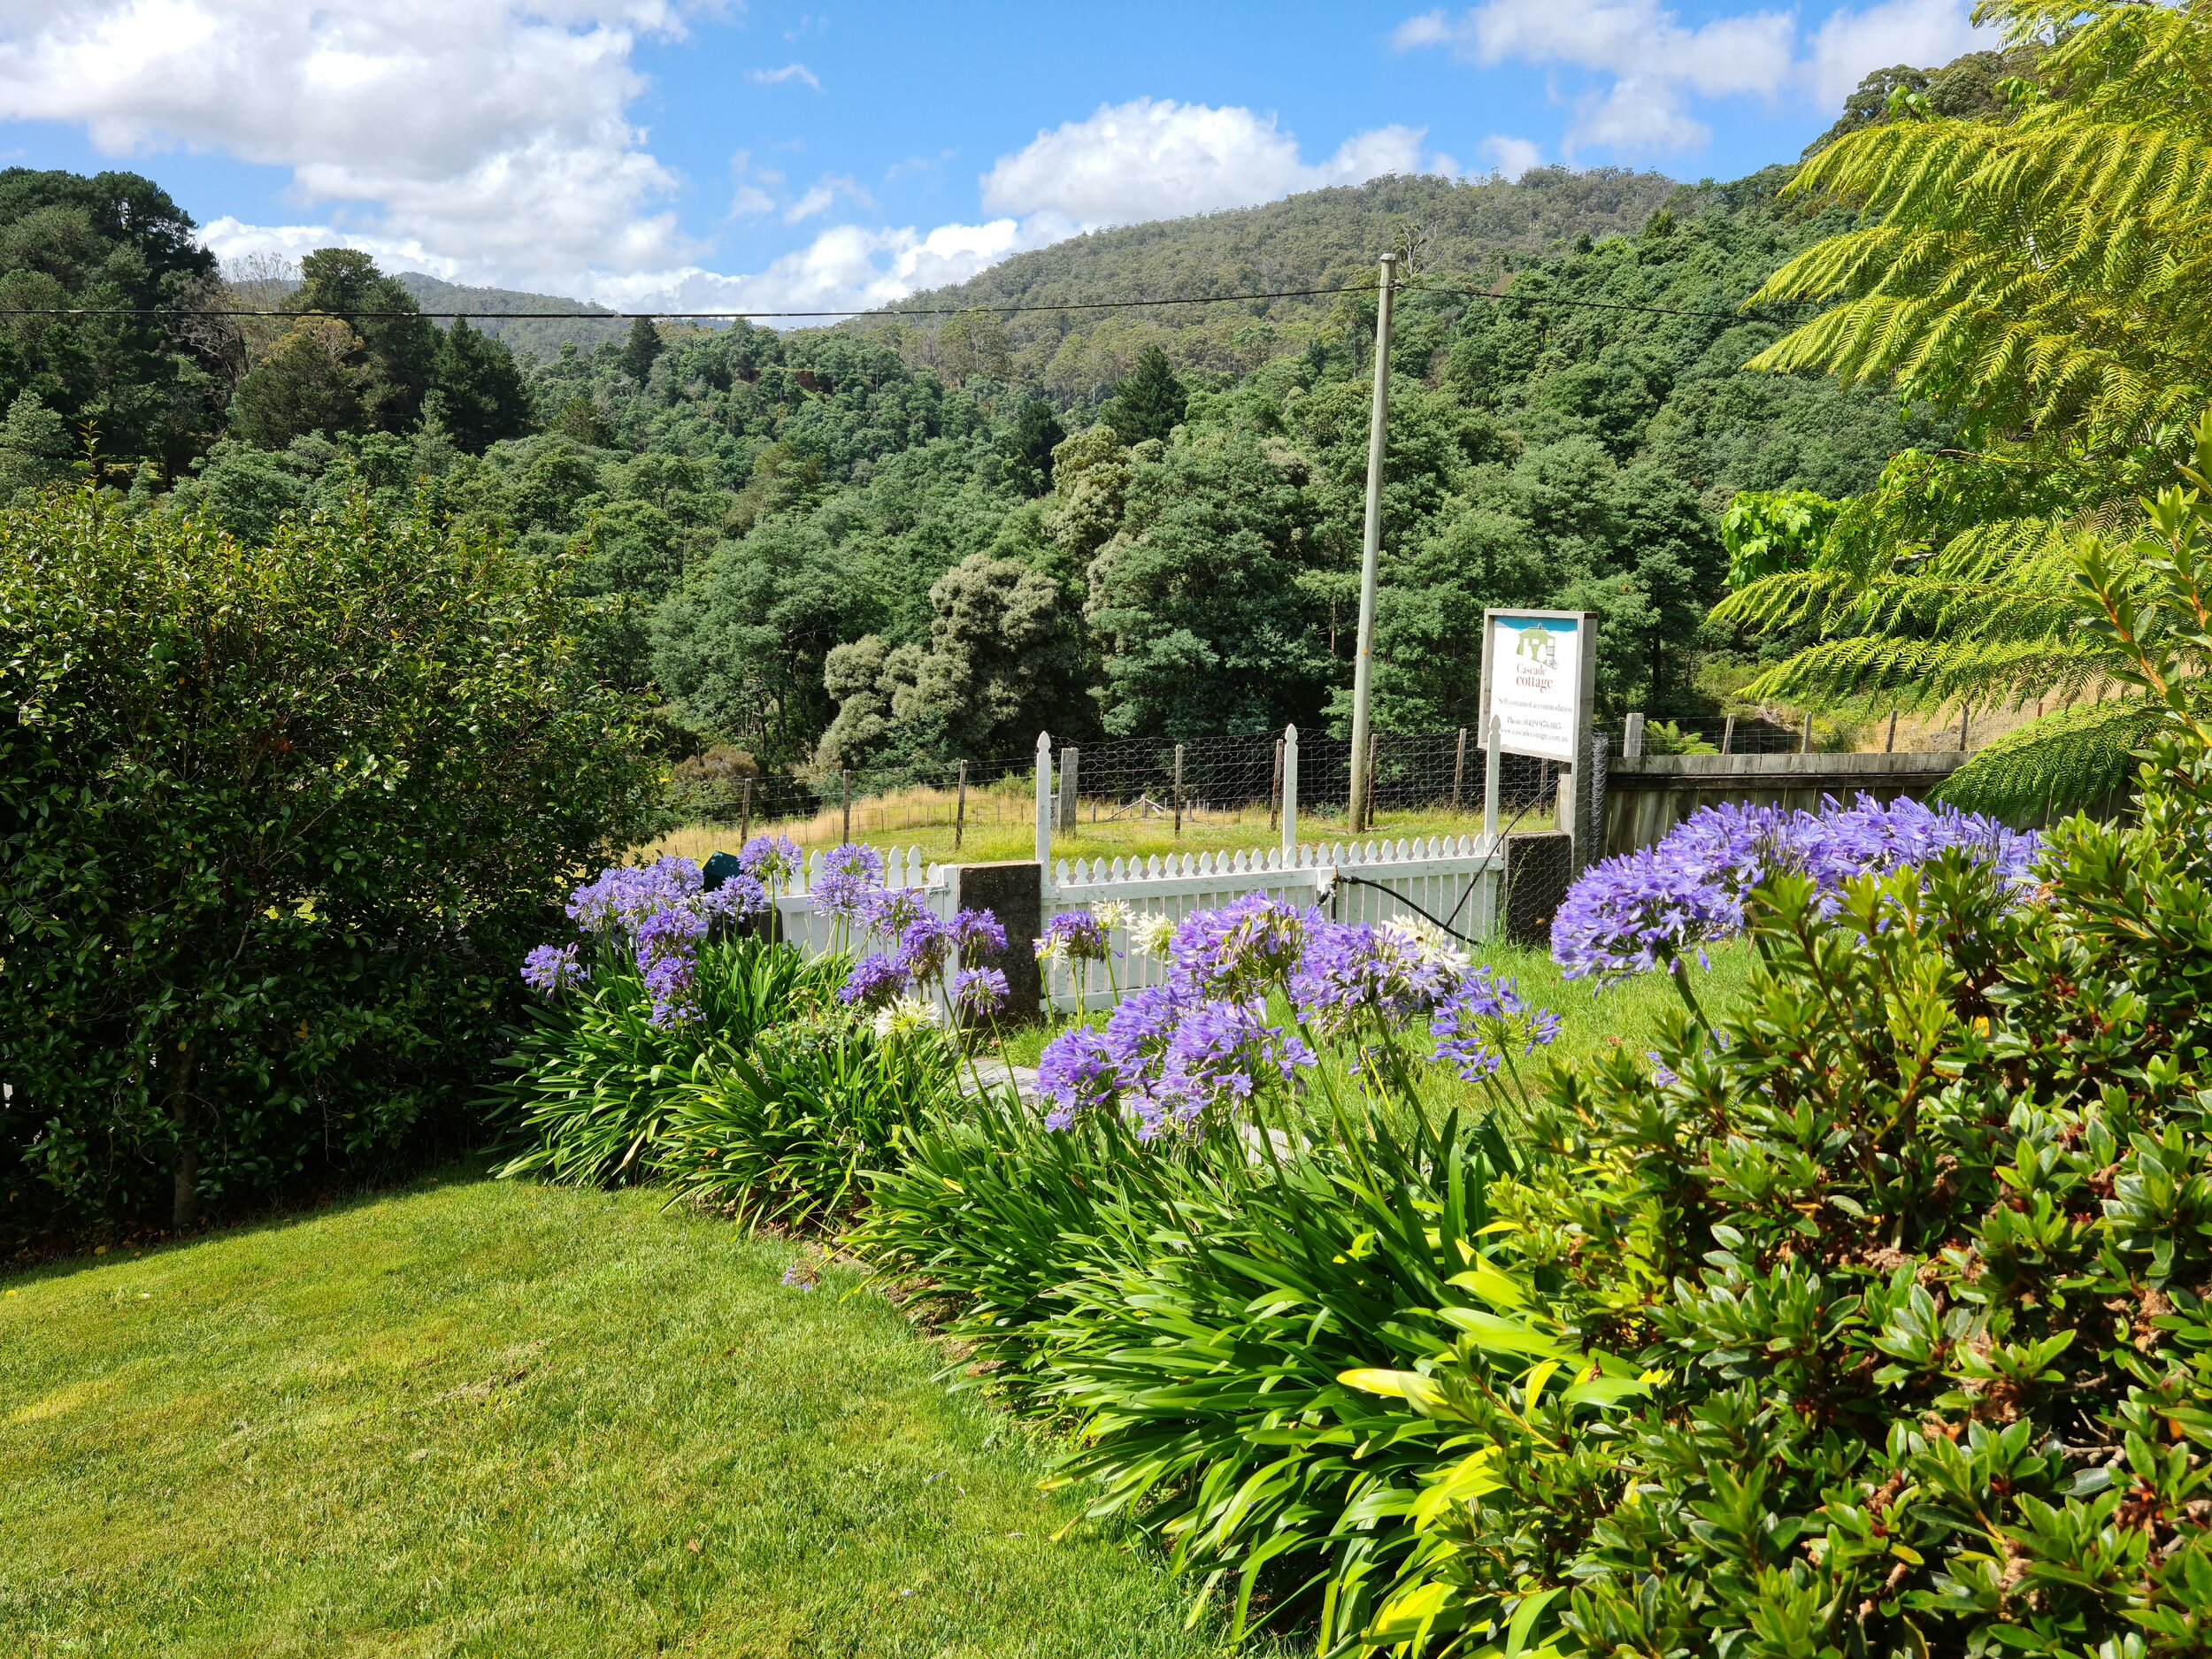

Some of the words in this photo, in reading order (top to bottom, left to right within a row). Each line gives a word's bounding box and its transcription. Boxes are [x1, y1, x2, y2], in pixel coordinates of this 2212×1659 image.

[1517, 664, 1547, 676] Cascade
[1516, 676, 1553, 693] cottage
[1508, 700, 1532, 709] contained
[1532, 703, 1573, 713] accommodation
[1524, 718, 1538, 727] 0429
